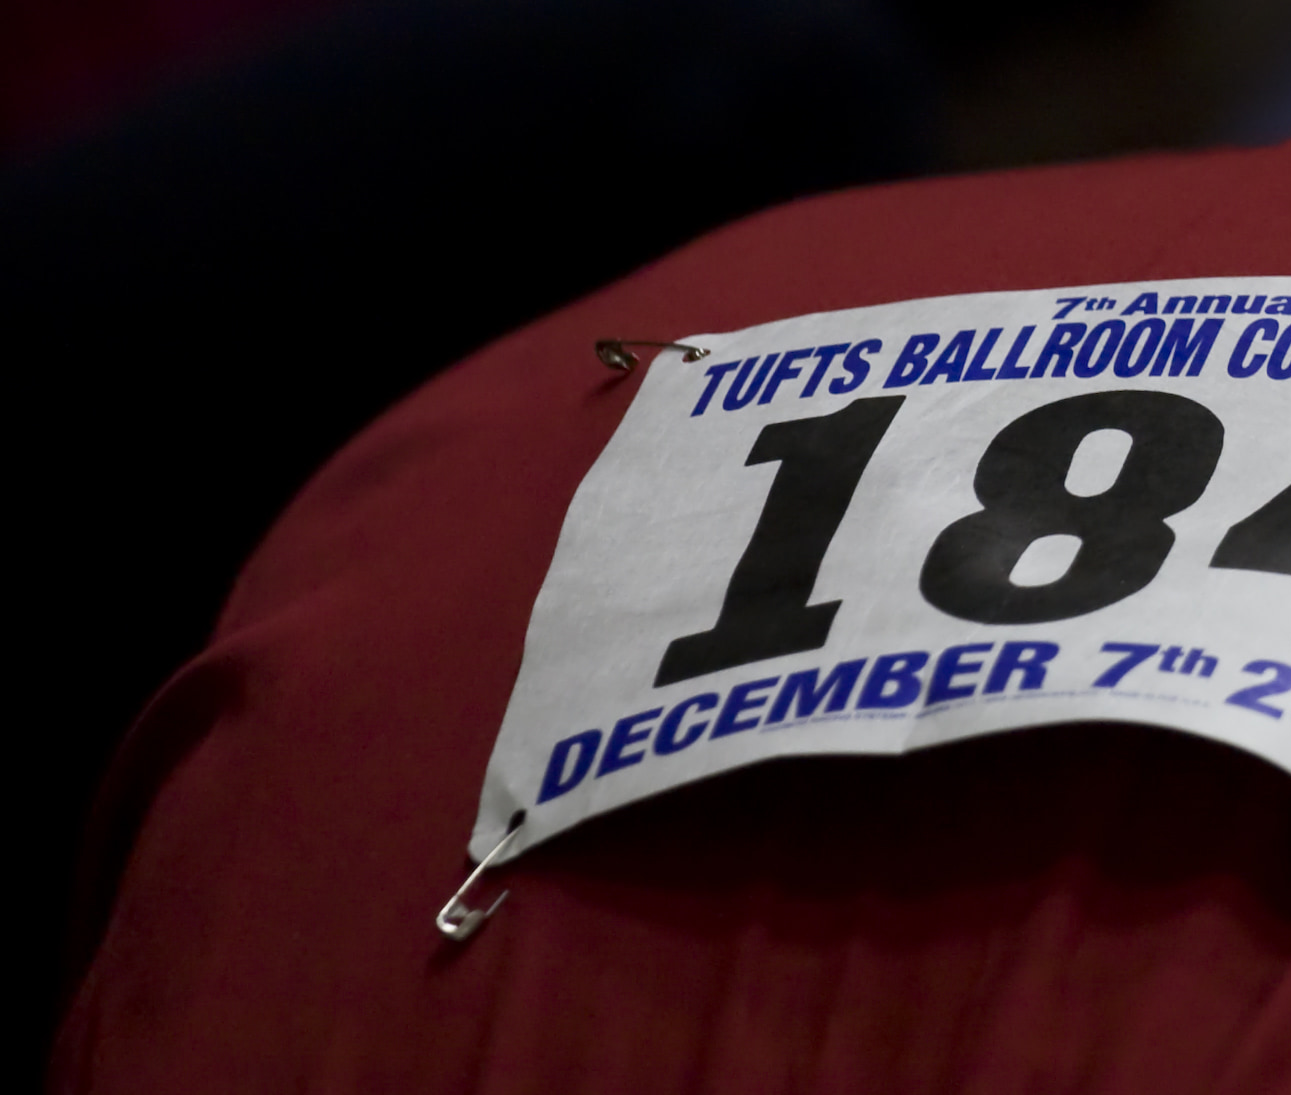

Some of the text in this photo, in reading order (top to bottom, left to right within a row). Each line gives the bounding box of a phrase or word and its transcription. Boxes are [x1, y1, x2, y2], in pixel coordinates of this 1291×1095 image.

[1052, 295, 1117, 320] 7th
[690, 338, 883, 417] TUFTS
[882, 317, 1226, 389] BALLROOM
[537, 640, 1060, 805] DECEMBER
[1092, 642, 1219, 689] 7th
